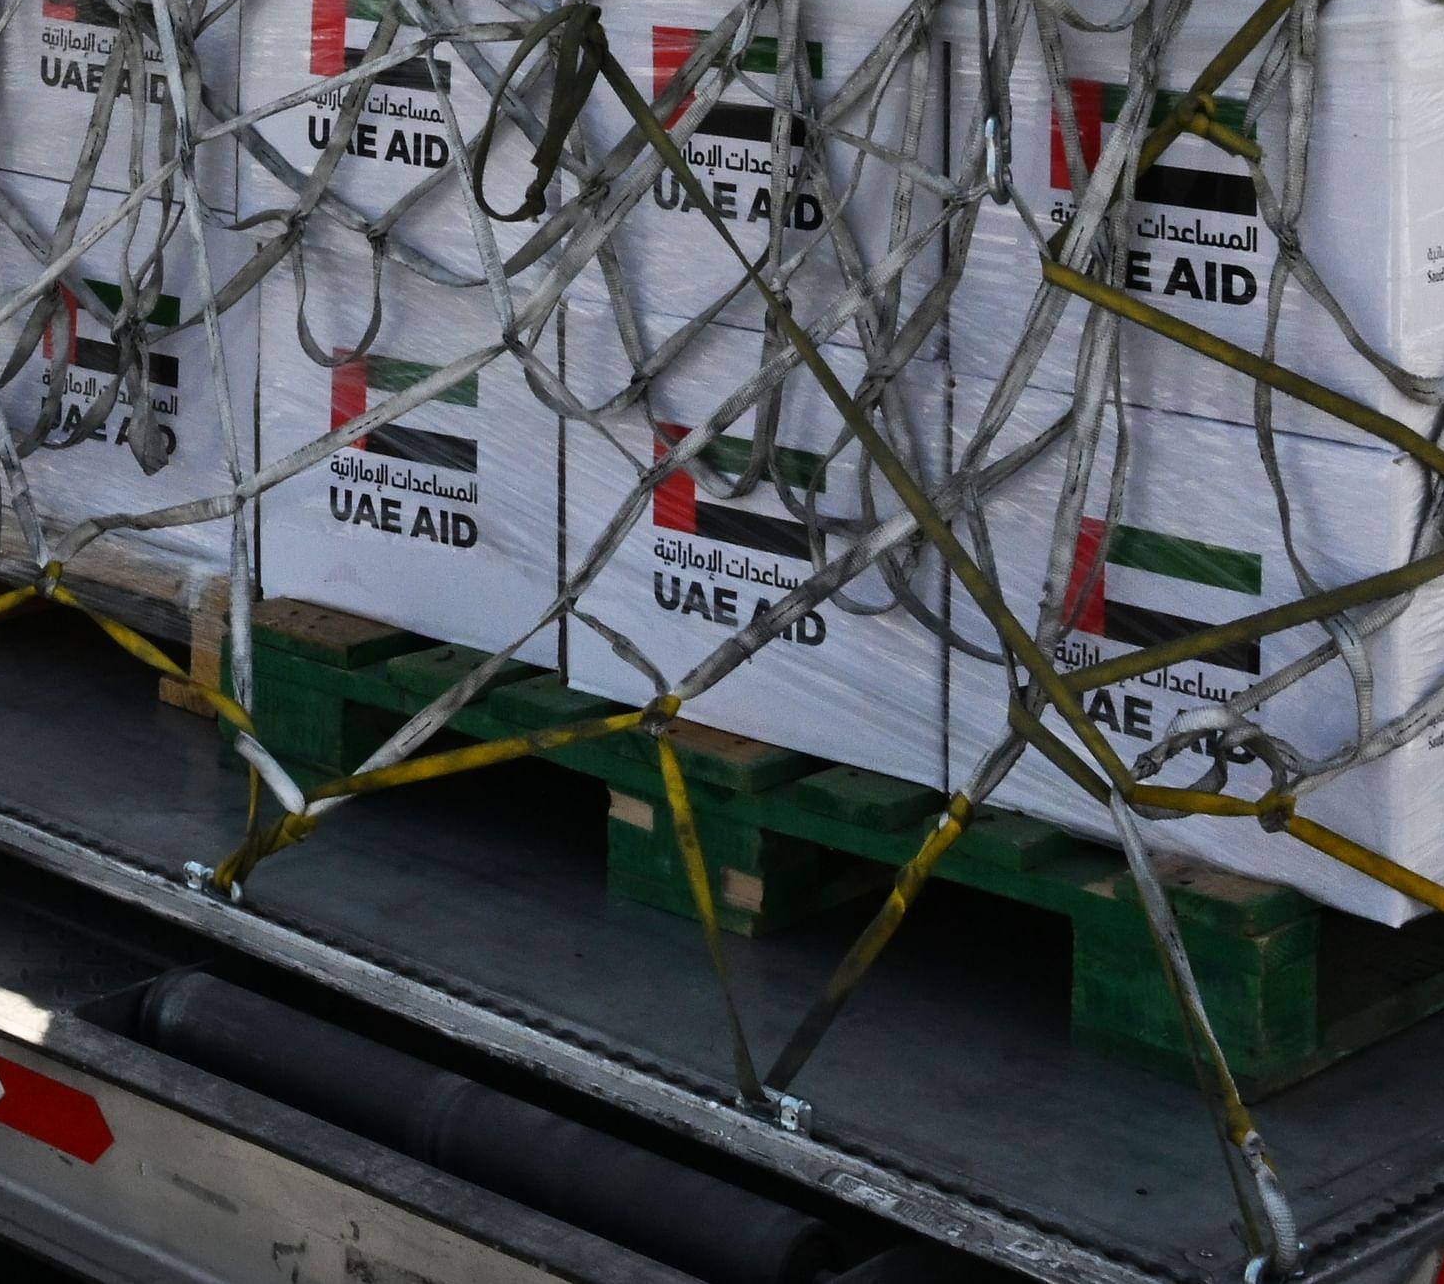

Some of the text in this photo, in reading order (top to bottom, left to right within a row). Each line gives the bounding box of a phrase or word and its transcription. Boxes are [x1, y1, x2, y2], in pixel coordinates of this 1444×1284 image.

[384, 129, 450, 169] AID
[1137, 214, 1258, 253] المساعدات
[1163, 257, 1257, 306] AID
[330, 454, 479, 505] المساعدات الإماراتية
[330, 486, 478, 549] UAE AID
[653, 537, 723, 581] الإماراتية
[653, 572, 739, 628] UAE
[1088, 688, 1153, 741] AE
